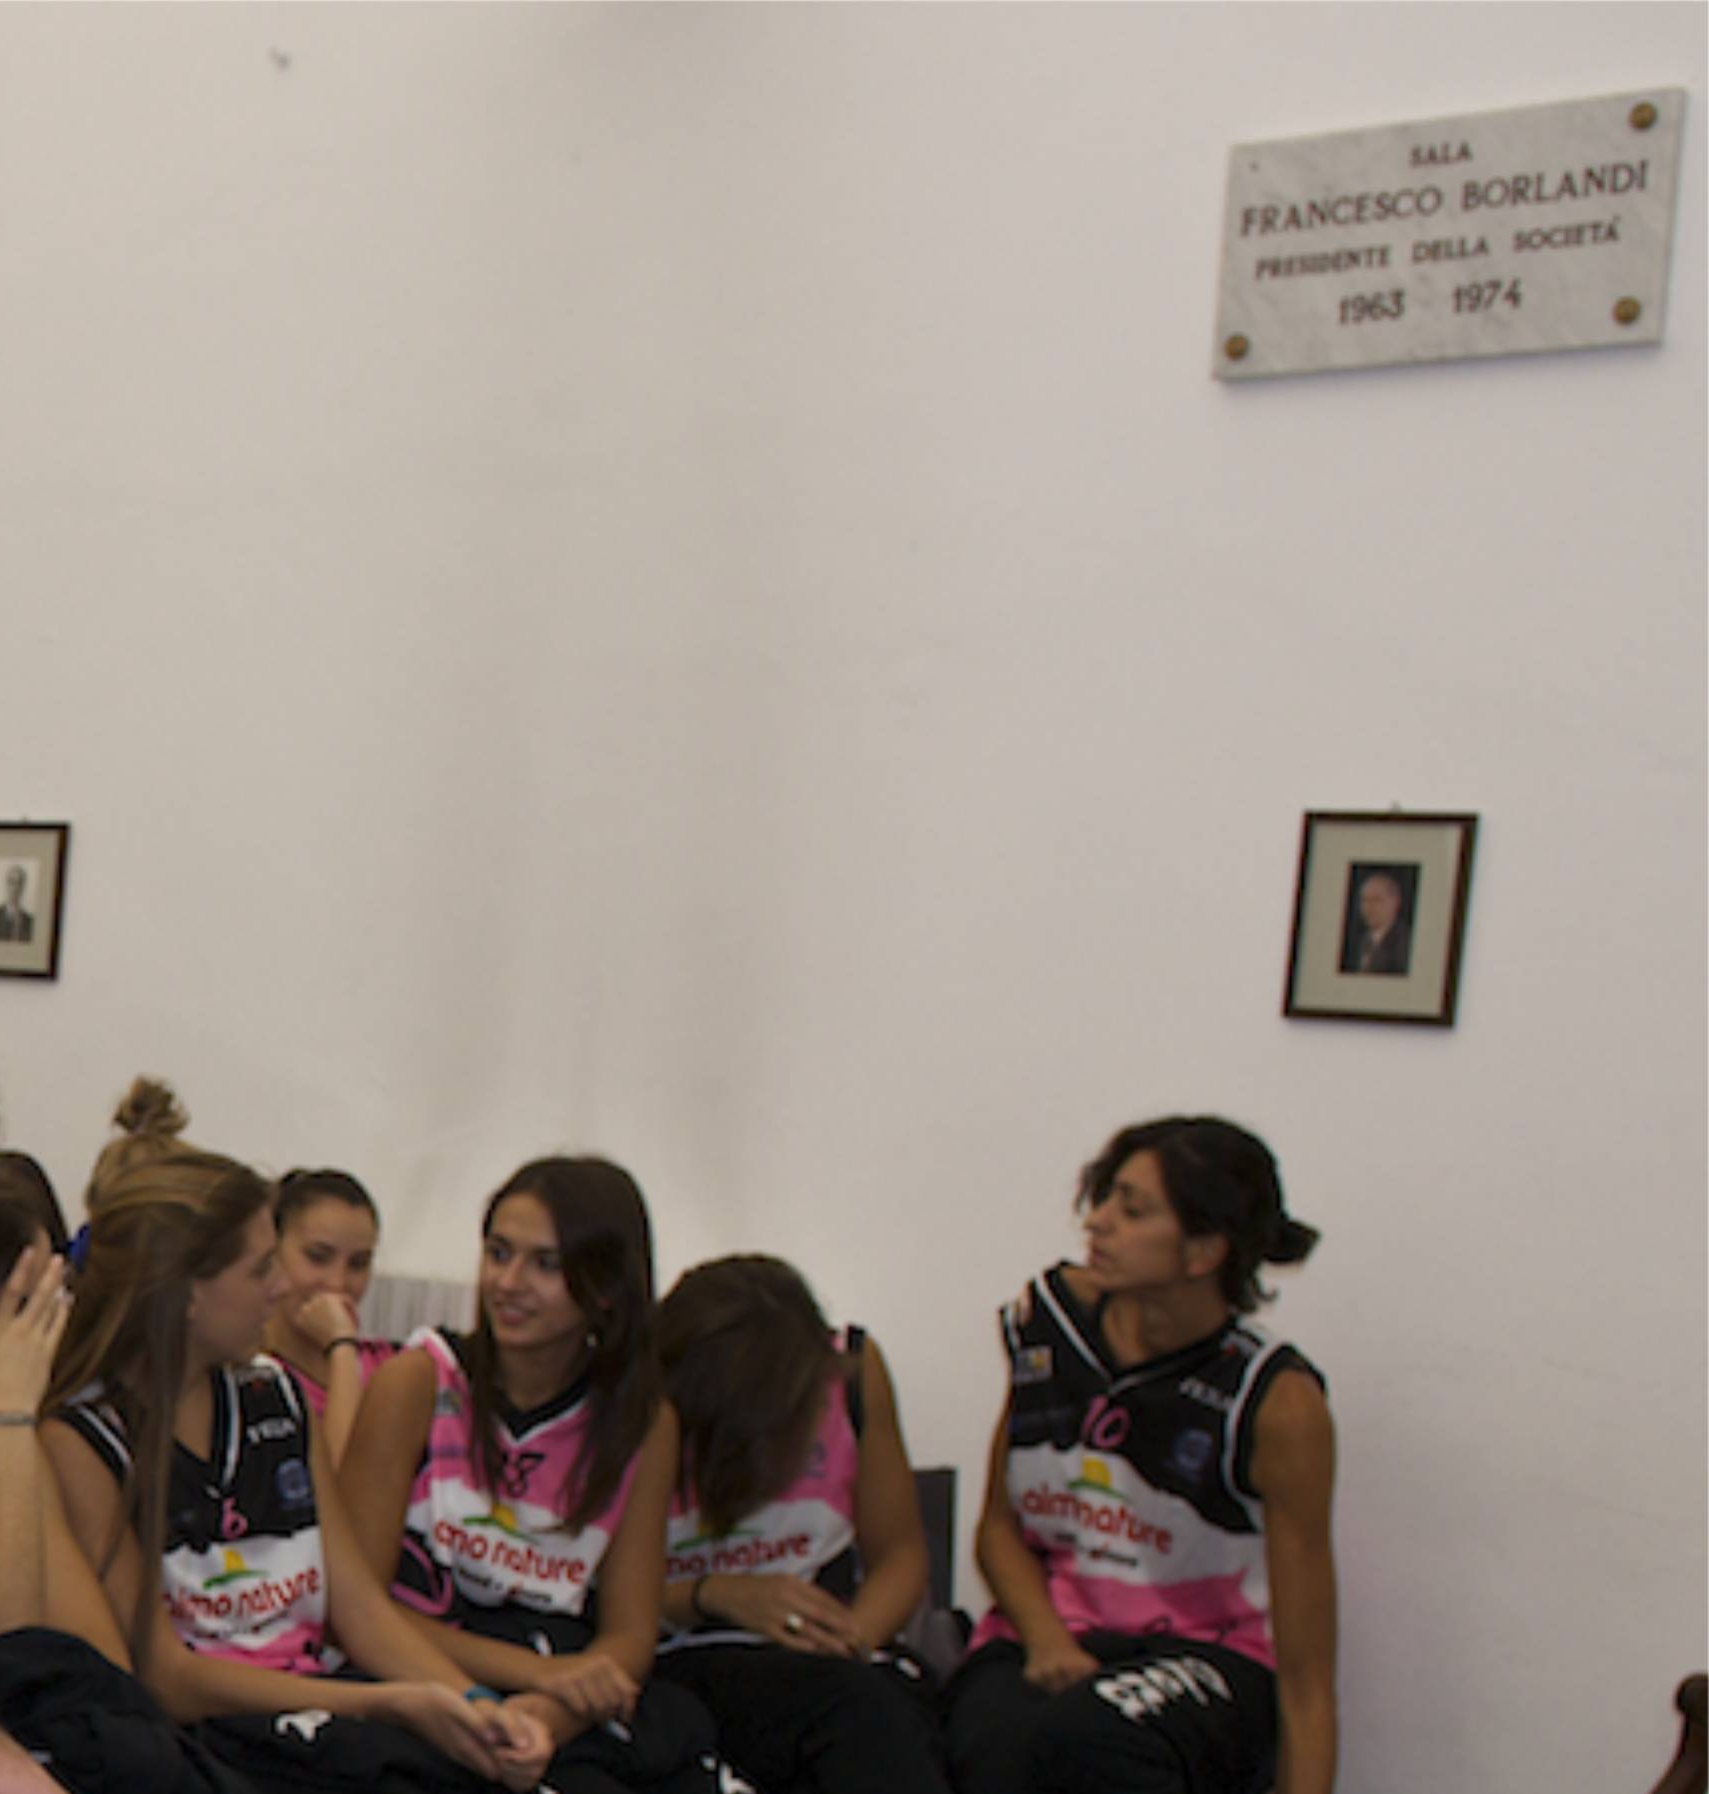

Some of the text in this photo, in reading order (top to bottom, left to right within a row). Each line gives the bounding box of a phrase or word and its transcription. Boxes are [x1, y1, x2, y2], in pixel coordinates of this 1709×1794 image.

[1410, 142, 1473, 168] SALA
[1239, 160, 1649, 238] FRANCESCO BORLANDI
[1255, 245, 1391, 280] PRESIDENTE
[1411, 237, 1490, 265] DELLA
[1339, 279, 1523, 325] 1963 1974
[491, 1541, 586, 1585] nature
